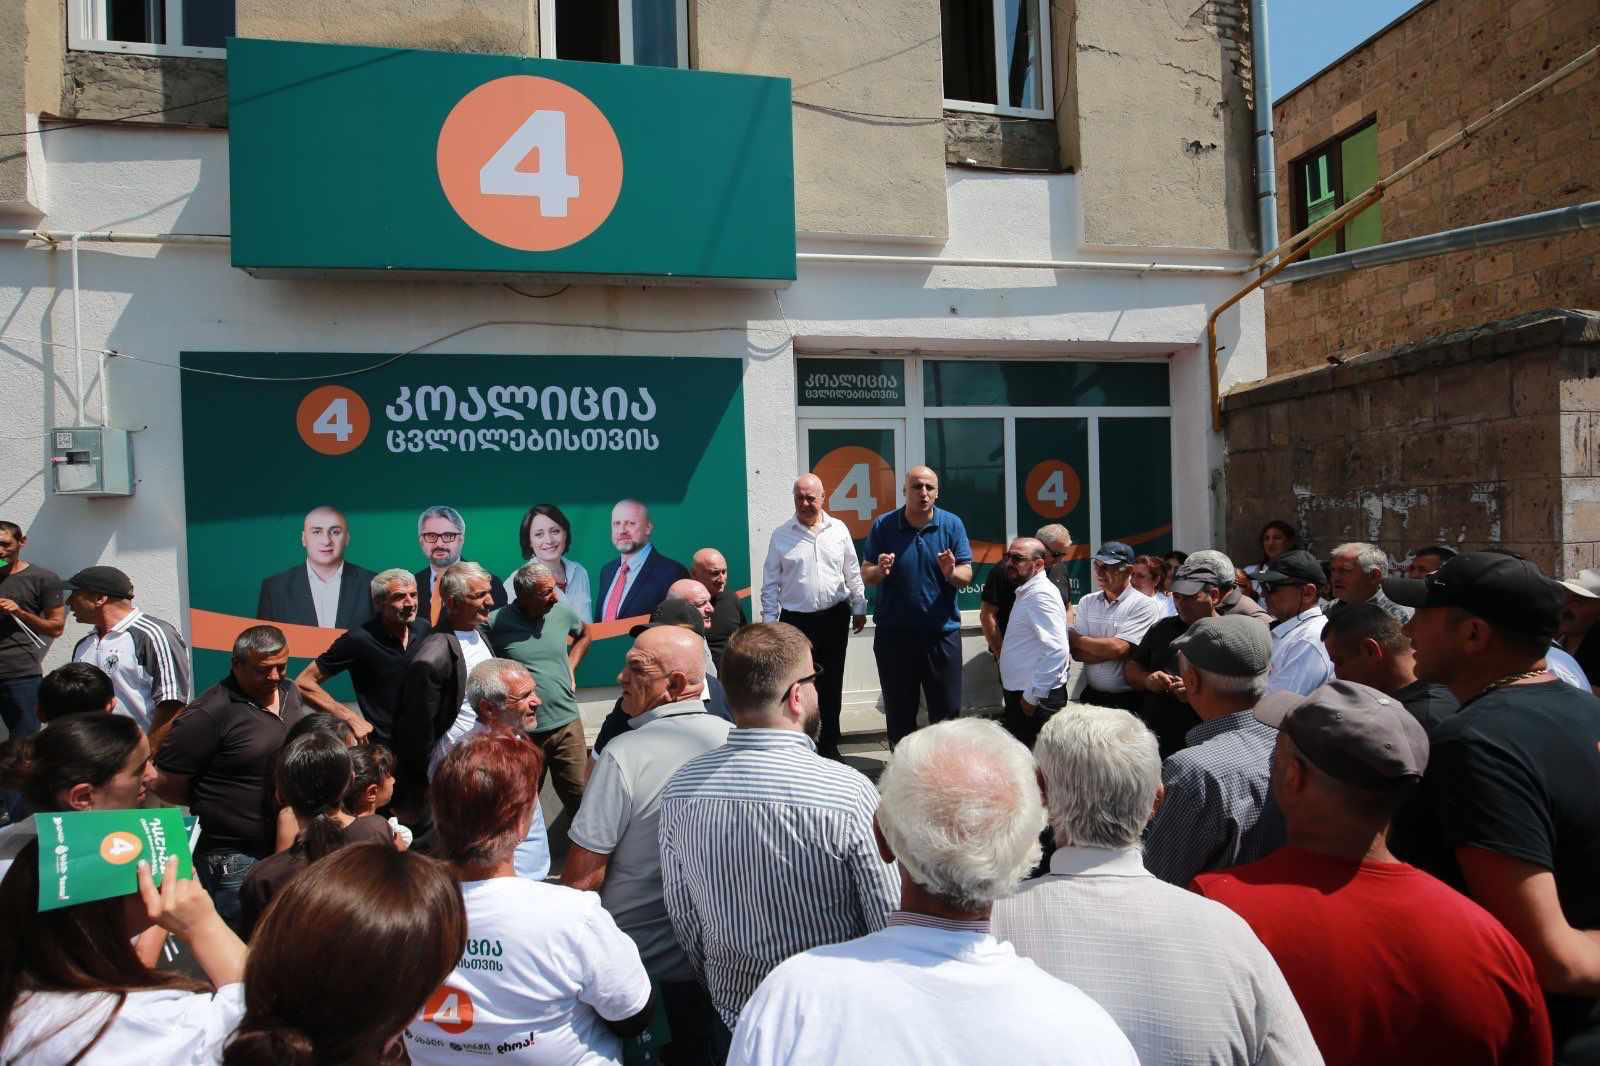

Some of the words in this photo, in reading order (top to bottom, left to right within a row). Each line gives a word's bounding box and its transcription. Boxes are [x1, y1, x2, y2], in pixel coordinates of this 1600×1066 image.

[479, 109, 580, 218] 4
[805, 374, 898, 388] კოალიცია
[805, 389, 899, 400] ცვლილებისთვის
[385, 385, 657, 422] კოალიცია
[312, 398, 353, 442] 4
[386, 428, 660, 453] ცვლილებისთვის
[828, 463, 878, 522] 4
[1037, 470, 1067, 508] 4
[108, 837, 134, 855] 4
[466, 938, 504, 958] ცია
[457, 957, 504, 972] ისთვის
[432, 993, 462, 1025] 4
